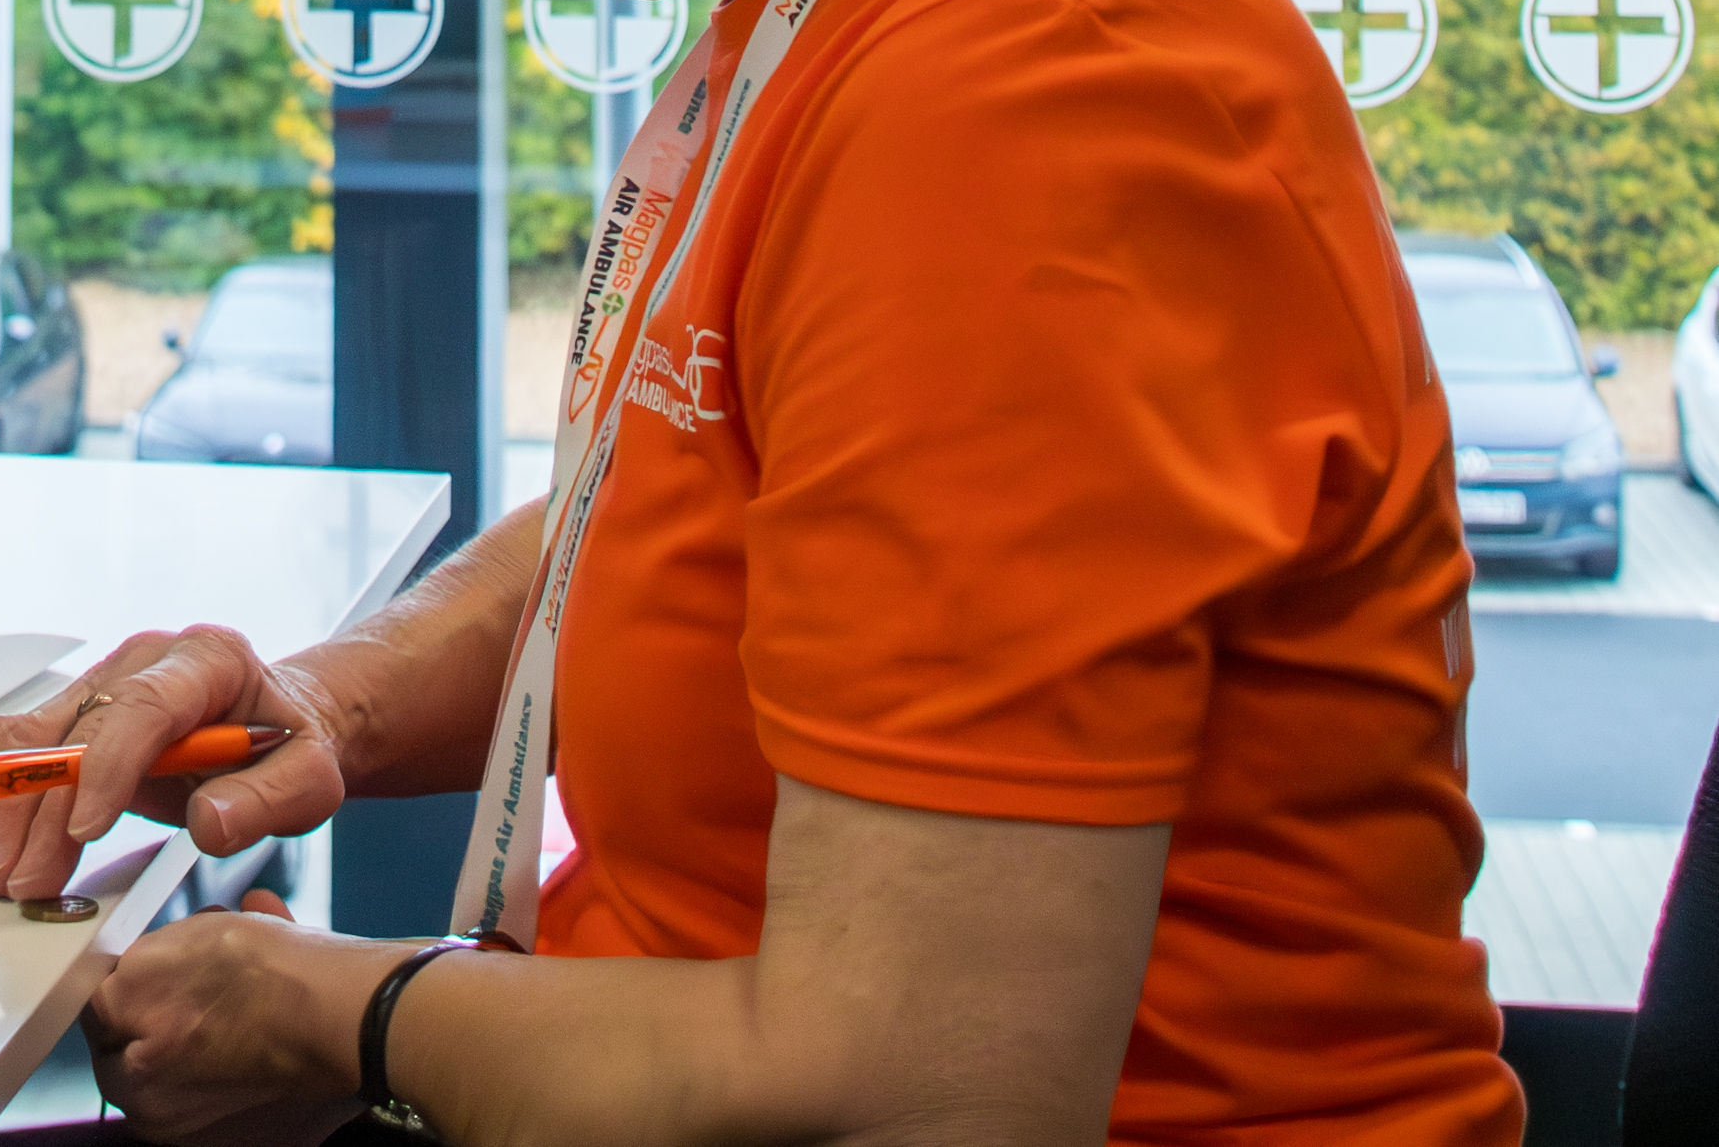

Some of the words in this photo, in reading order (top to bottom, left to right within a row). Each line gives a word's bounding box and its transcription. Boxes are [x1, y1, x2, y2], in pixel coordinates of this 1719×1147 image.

[592, 174, 641, 217] AIR
[612, 189, 673, 292] Magpas
[571, 219, 624, 366] AMBULANCE
[502, 692, 533, 816] Ambulance
[494, 816, 514, 855] Air
